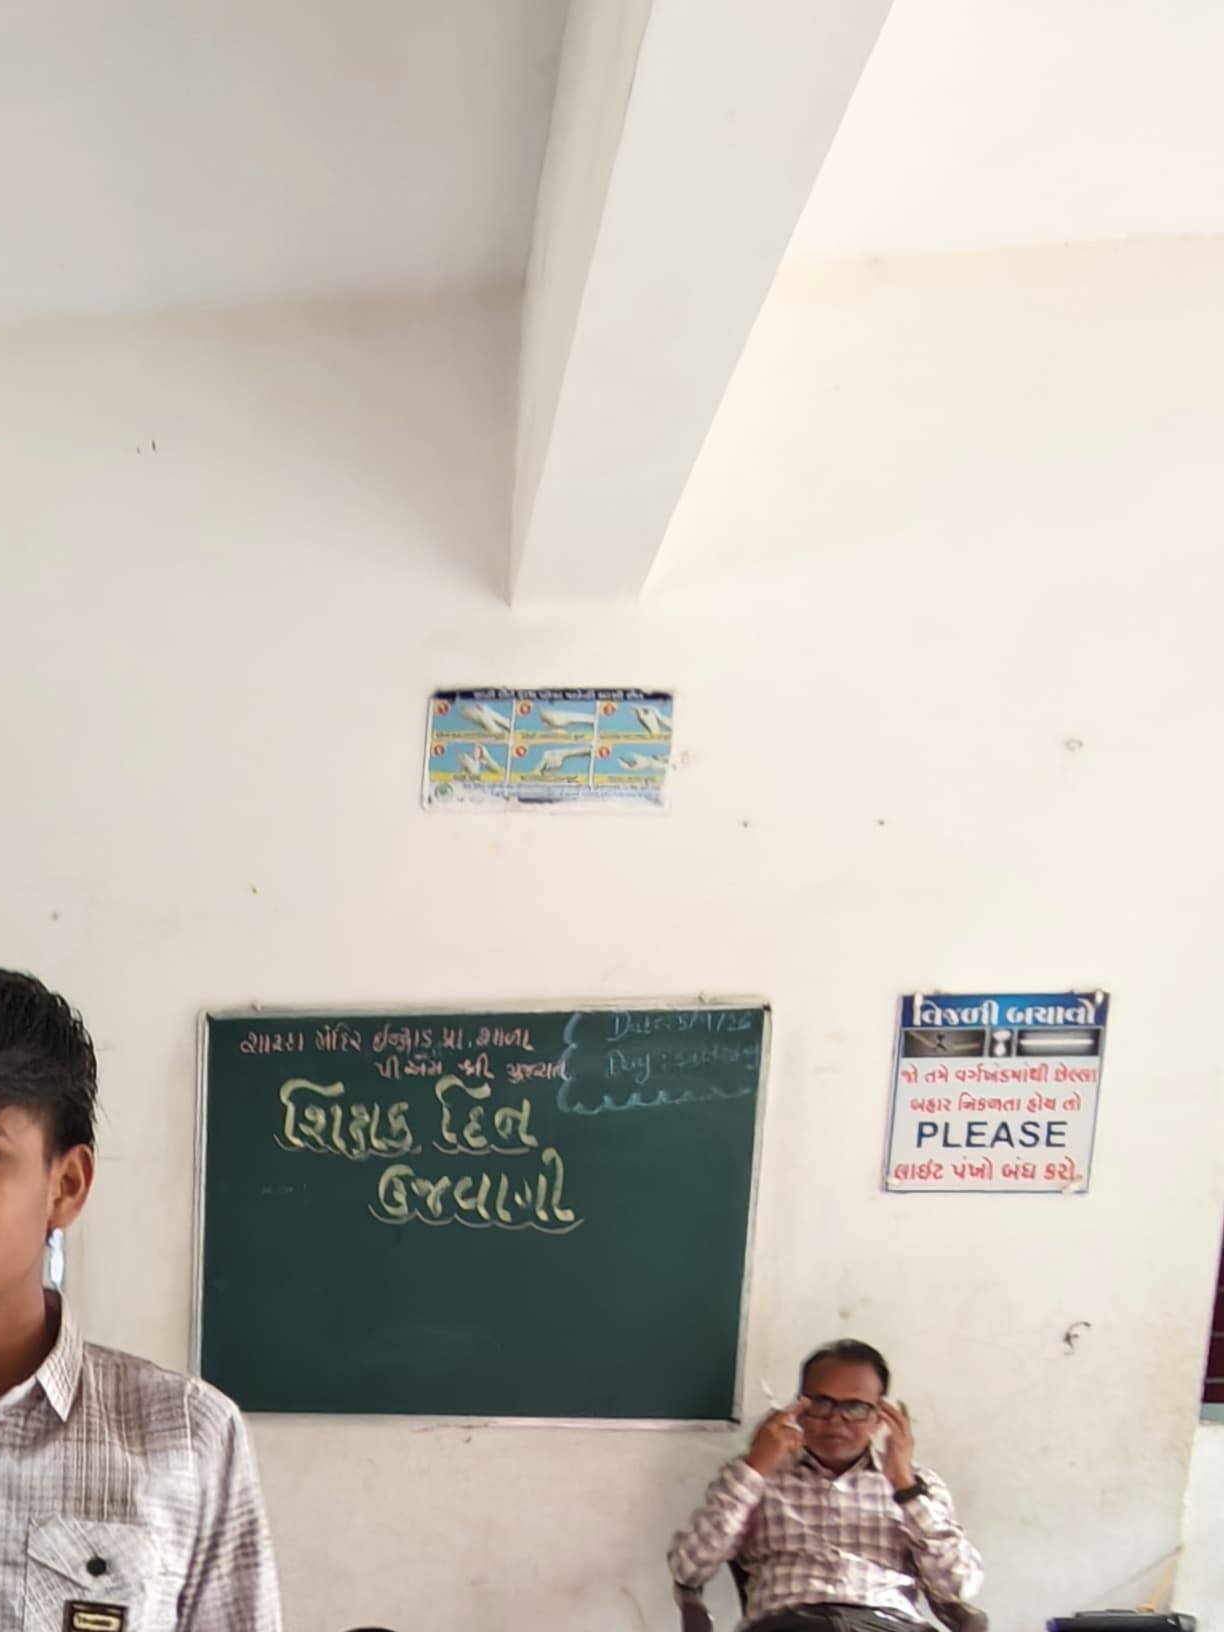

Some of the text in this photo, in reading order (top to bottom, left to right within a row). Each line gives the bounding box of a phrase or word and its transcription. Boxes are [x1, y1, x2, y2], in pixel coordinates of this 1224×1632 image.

[913, 998, 1096, 1025] વિજળી બચાવો
[901, 1064, 918, 1082] જો
[925, 1064, 949, 1083] તમે
[910, 1098, 951, 1113] બહાર
[1026, 1092, 1056, 1113] હોય
[1062, 1092, 1081, 1112] તો
[279, 1075, 538, 1158] શિક્ષક દિન
[916, 1121, 1068, 1148] PLEASE
[893, 1159, 944, 1180] લાઈટ
[952, 1156, 993, 1180] પંખો
